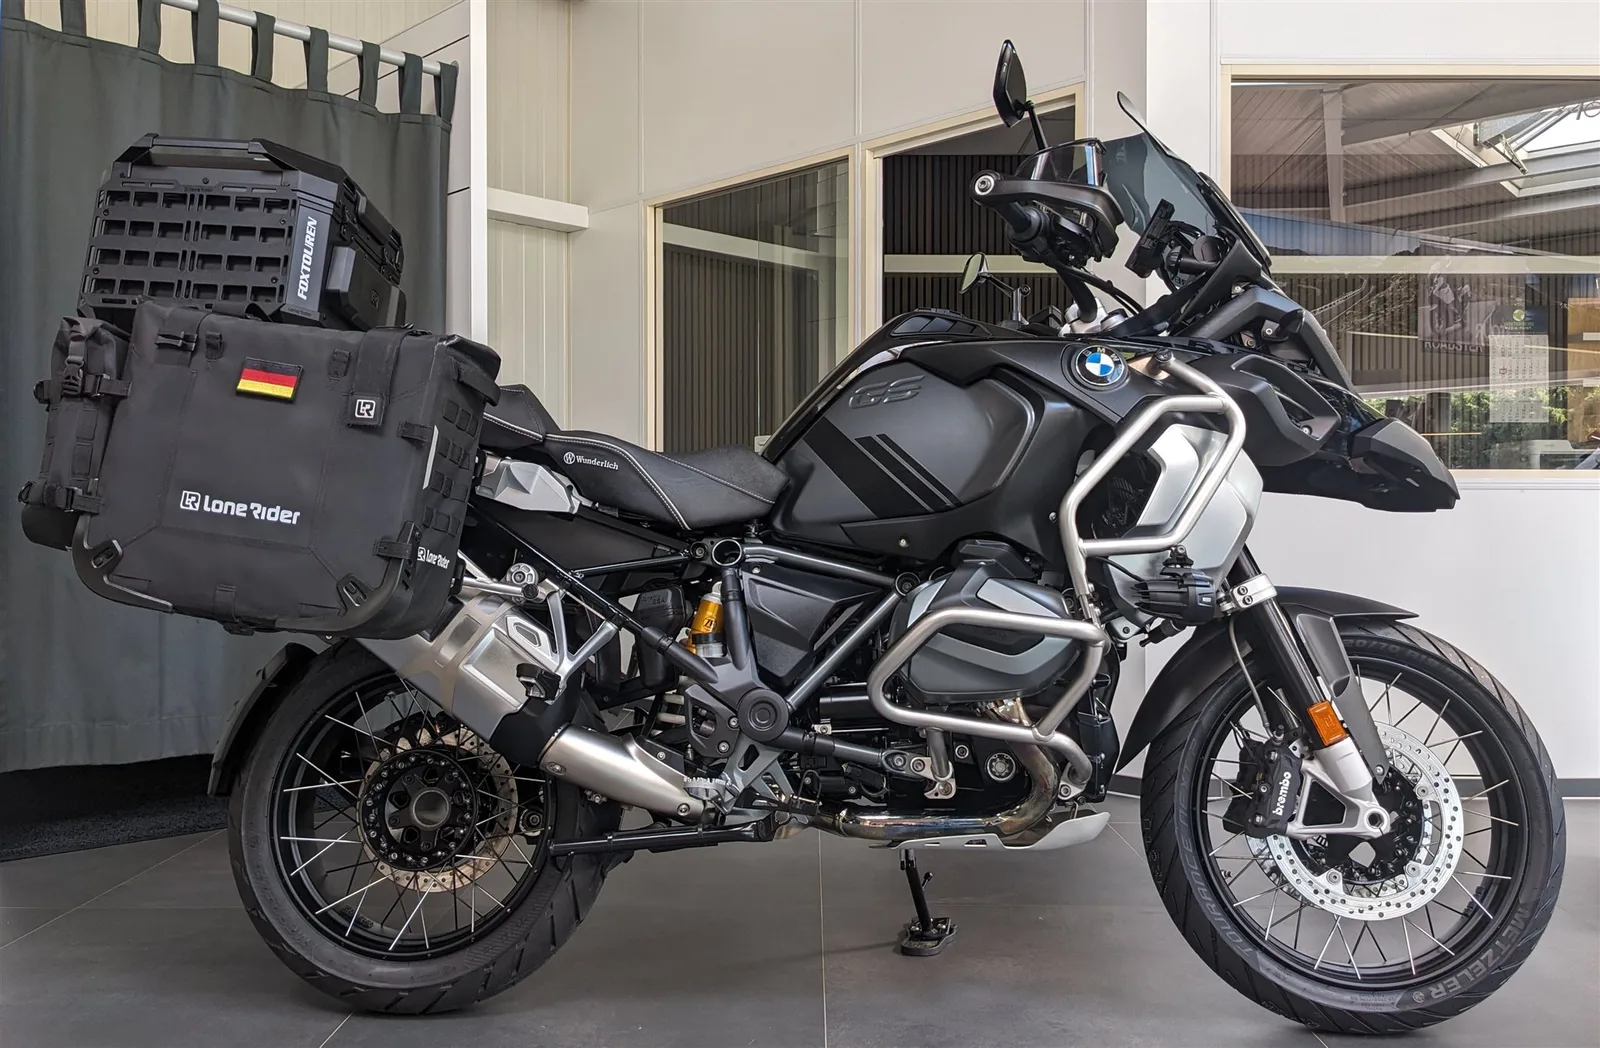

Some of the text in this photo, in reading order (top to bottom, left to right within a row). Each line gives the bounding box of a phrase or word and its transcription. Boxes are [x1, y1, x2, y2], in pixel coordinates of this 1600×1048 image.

[297, 216, 317, 300] FOXTOUREN
[848, 374, 925, 409] GS
[576, 455, 619, 470] Wunderlich
[203, 495, 248, 517] Lone
[250, 502, 300, 525] Rider
[1272, 771, 1292, 816] brembo
[1182, 838, 1254, 958] TOURANCE
[1428, 904, 1532, 999] METZELER
